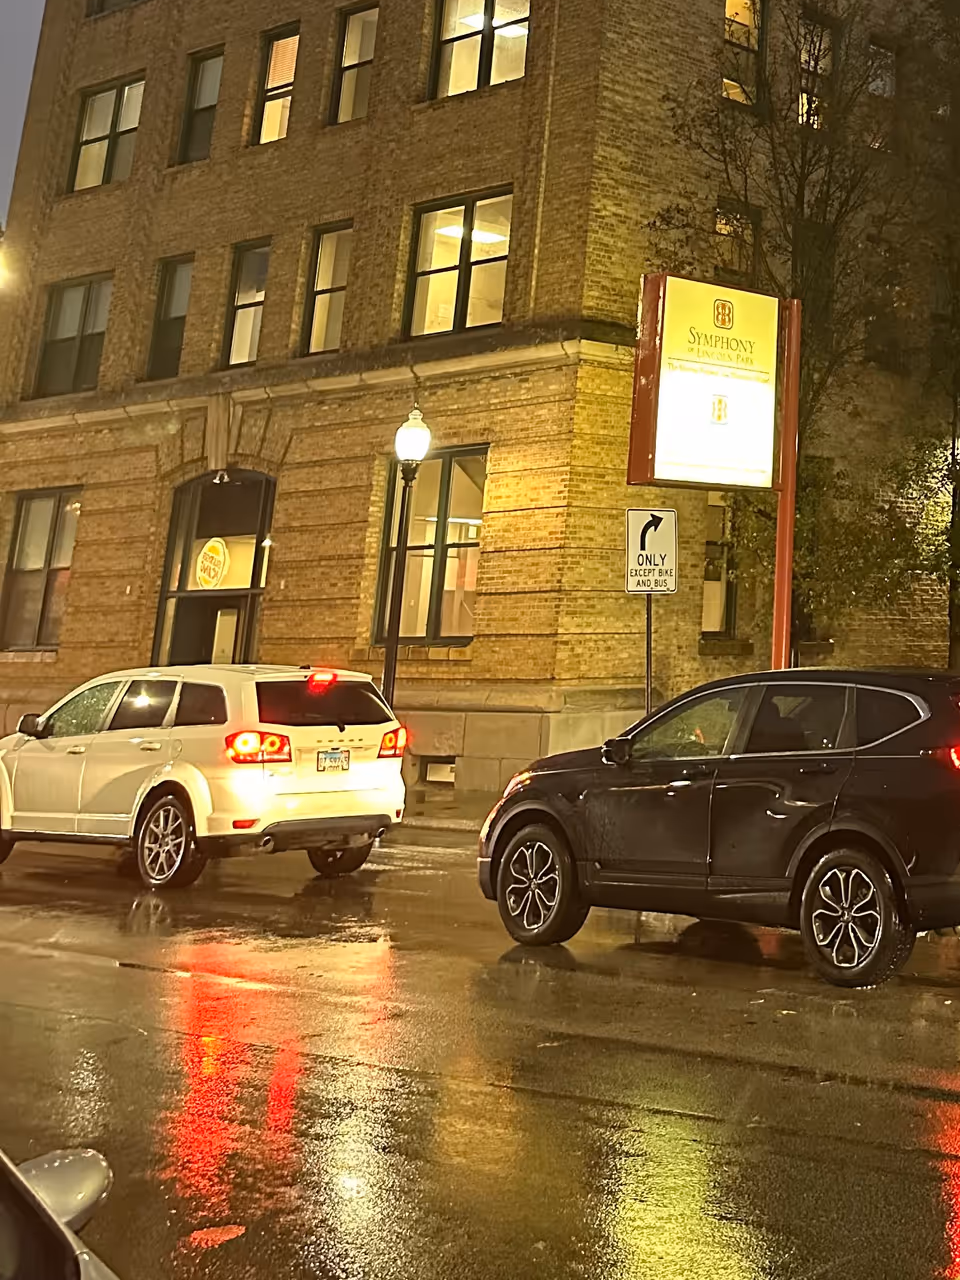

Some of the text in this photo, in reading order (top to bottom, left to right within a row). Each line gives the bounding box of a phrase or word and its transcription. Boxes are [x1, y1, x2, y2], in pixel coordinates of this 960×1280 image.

[688, 326, 756, 354] SYMPHONY
[736, 354, 754, 366] PARK
[637, 553, 667, 566] ONLY
[630, 568, 674, 577] EXCEPT BIKE
[636, 579, 668, 587] AND BUS
